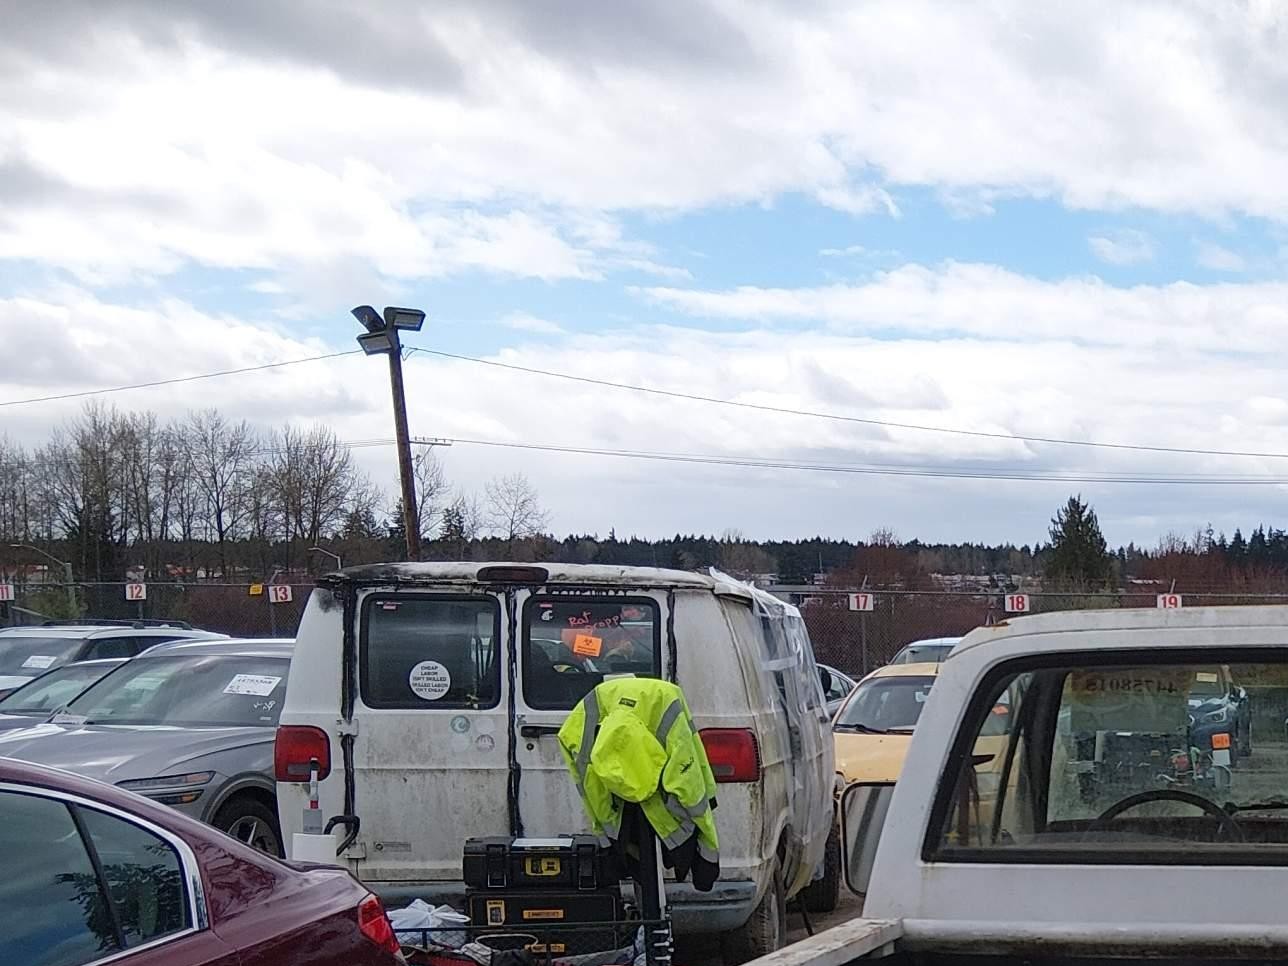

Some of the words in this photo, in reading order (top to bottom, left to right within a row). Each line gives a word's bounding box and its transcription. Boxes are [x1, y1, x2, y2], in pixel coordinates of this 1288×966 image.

[129, 584, 142, 599] 12
[273, 586, 289, 602] 13
[855, 594, 868, 610] 17
[1009, 595, 1025, 611] 18
[1161, 595, 1178, 608] 19
